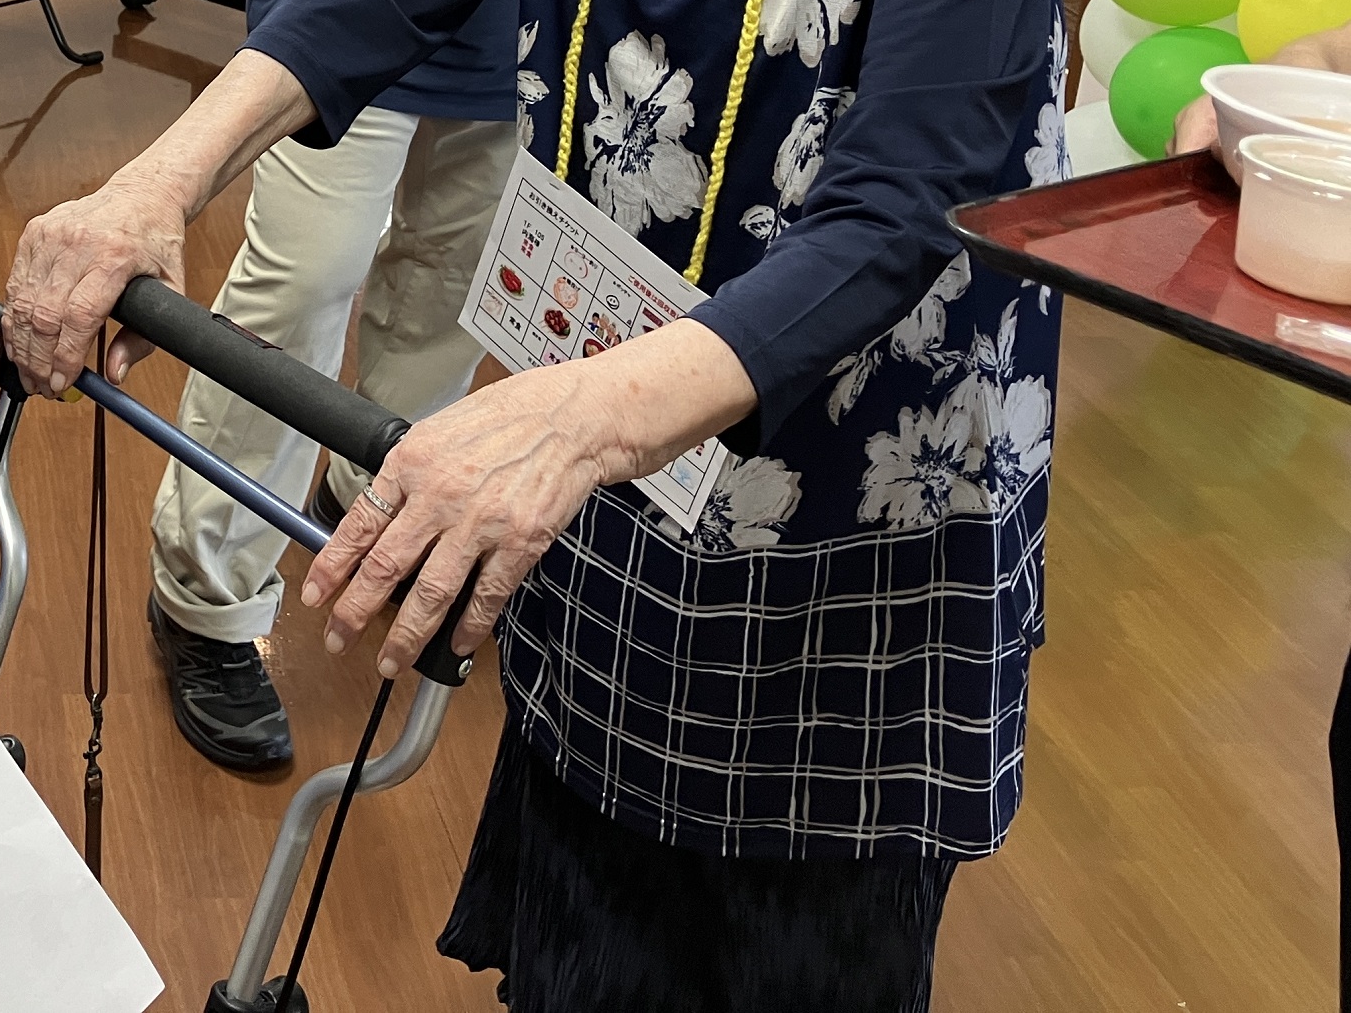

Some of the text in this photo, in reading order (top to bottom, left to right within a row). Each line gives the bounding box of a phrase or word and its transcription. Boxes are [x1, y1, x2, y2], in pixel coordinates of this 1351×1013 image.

[528, 192, 580, 236] お引き換えチケット
